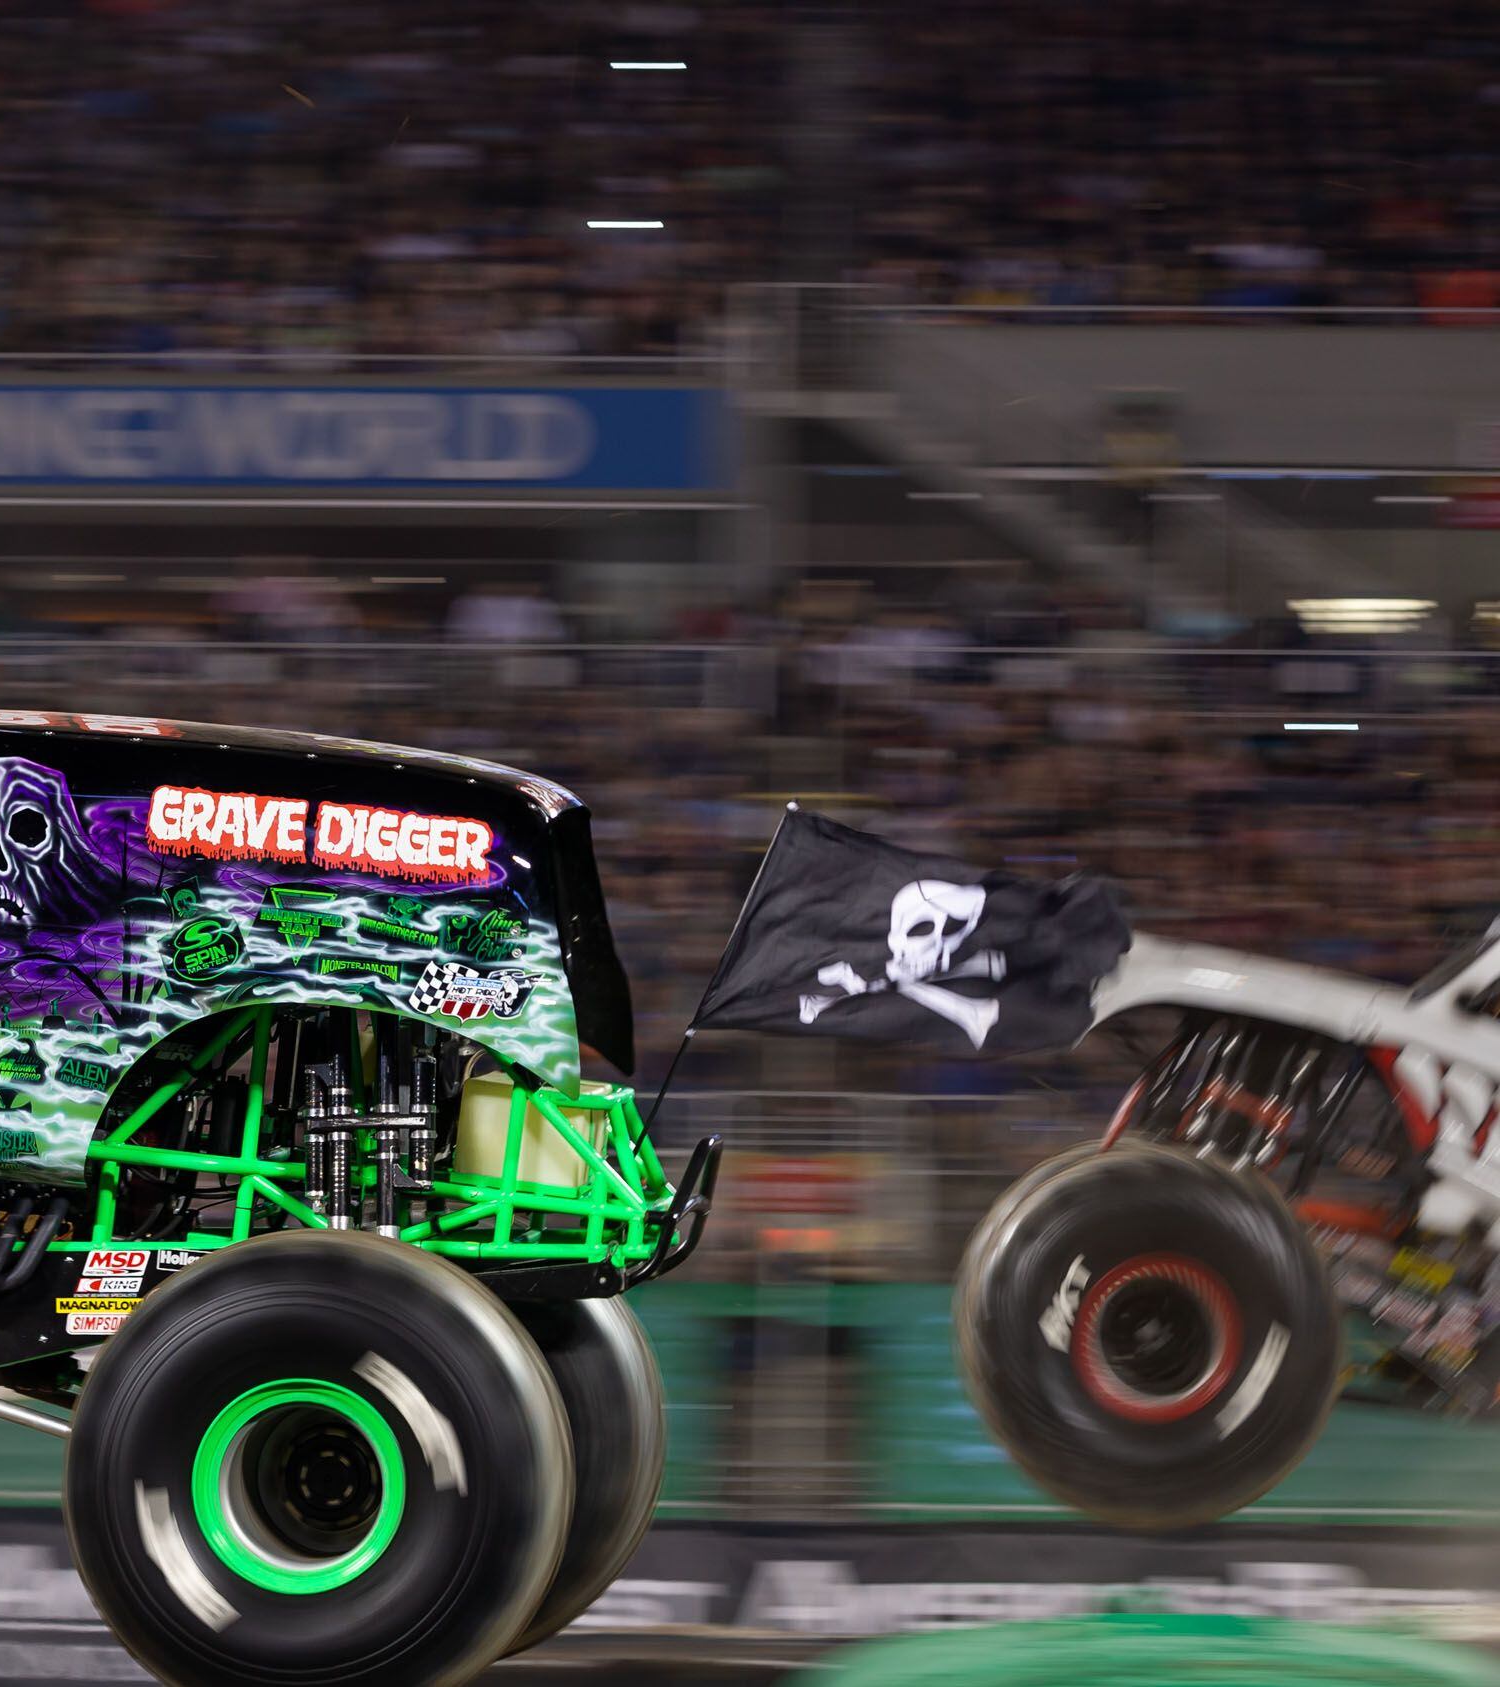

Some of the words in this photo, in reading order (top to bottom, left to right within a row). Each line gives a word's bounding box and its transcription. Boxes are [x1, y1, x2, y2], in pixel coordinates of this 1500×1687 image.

[148, 785, 307, 855] GRAVE
[316, 801, 491, 874] DIGGER
[259, 907, 344, 929] MONSTER
[278, 922, 321, 938] JAM
[184, 943, 227, 969] SPIN
[187, 956, 229, 975] MASTER
[320, 958, 399, 982] MONSTERJAM.COM
[59, 1057, 109, 1084] ALIEN
[59, 1074, 106, 1091] INVASION
[88, 1252, 146, 1268] MSD
[160, 1250, 201, 1266] Holle
[103, 1280, 138, 1290] KING
